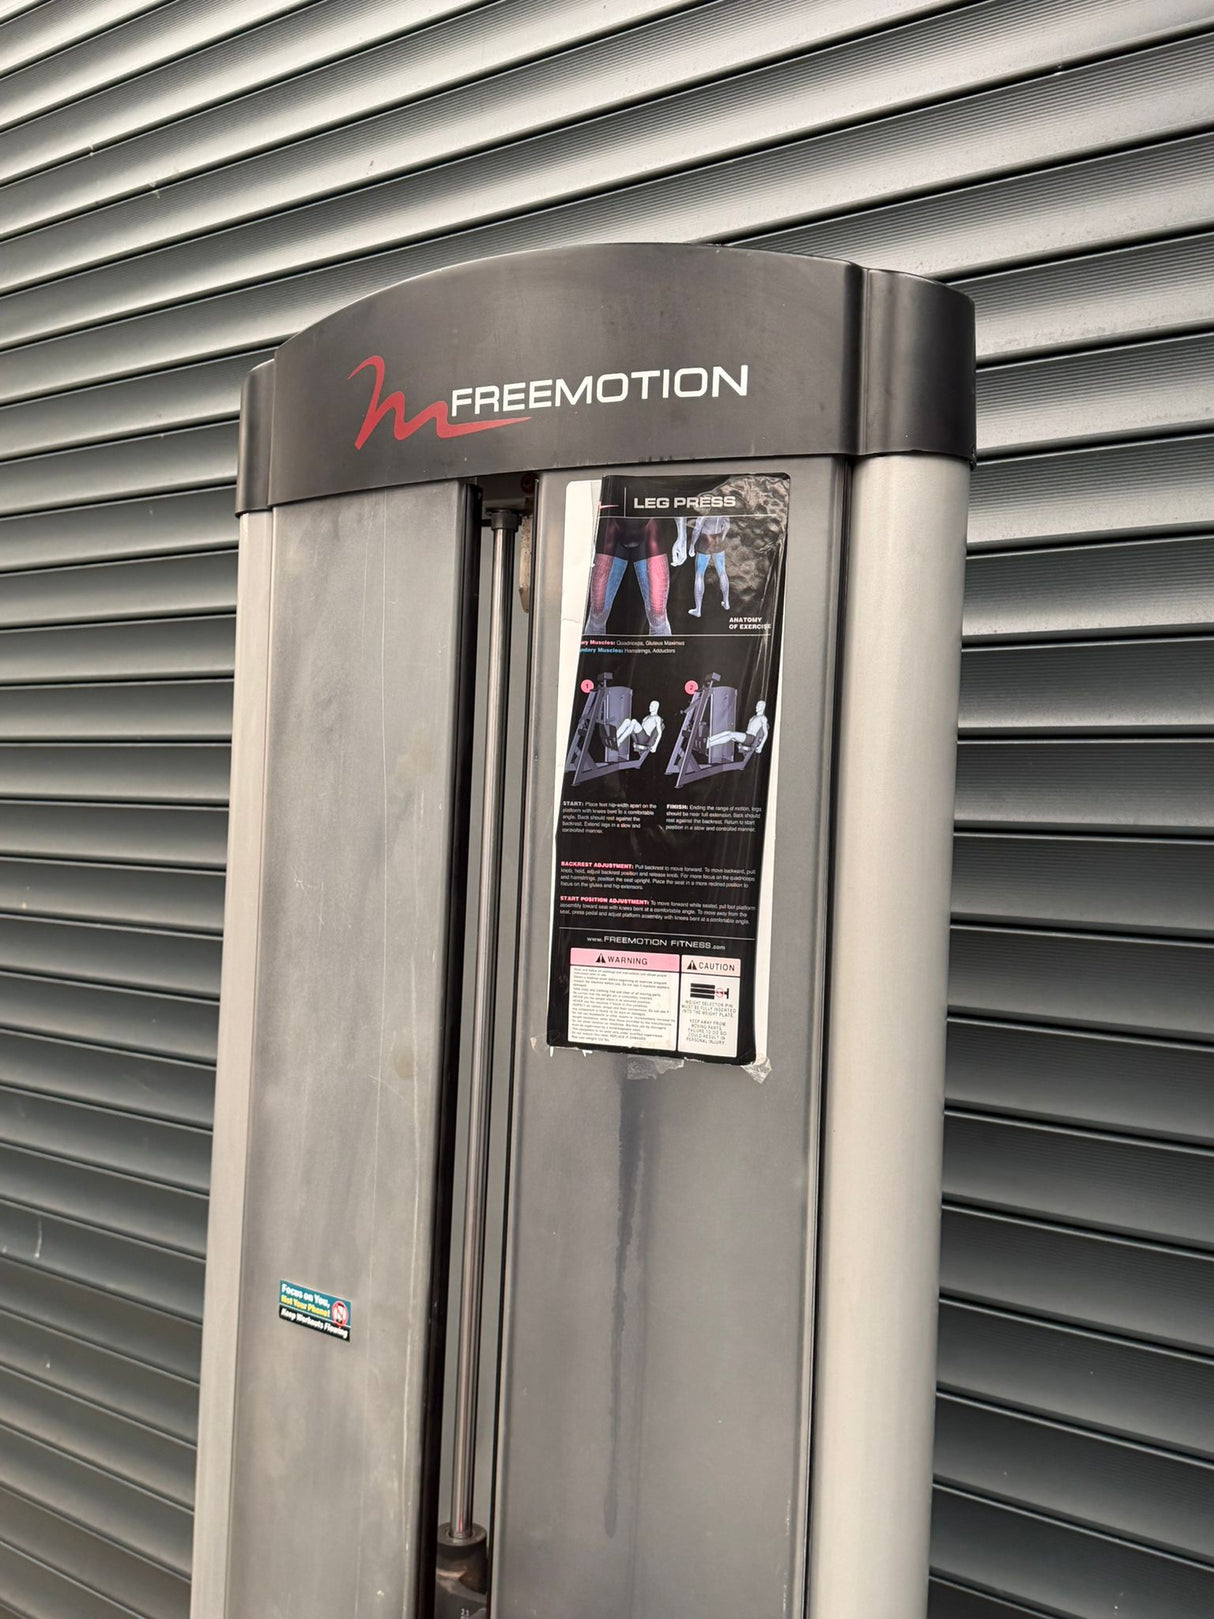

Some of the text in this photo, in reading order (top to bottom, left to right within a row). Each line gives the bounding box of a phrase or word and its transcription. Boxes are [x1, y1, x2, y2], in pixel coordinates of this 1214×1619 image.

[451, 364, 749, 417] FREEMOTION
[633, 495, 736, 509] LEG PRESS
[607, 955, 648, 965] WARNING
[698, 961, 735, 972] CAUTION
[281, 1283, 330, 1309] Focus on You,
